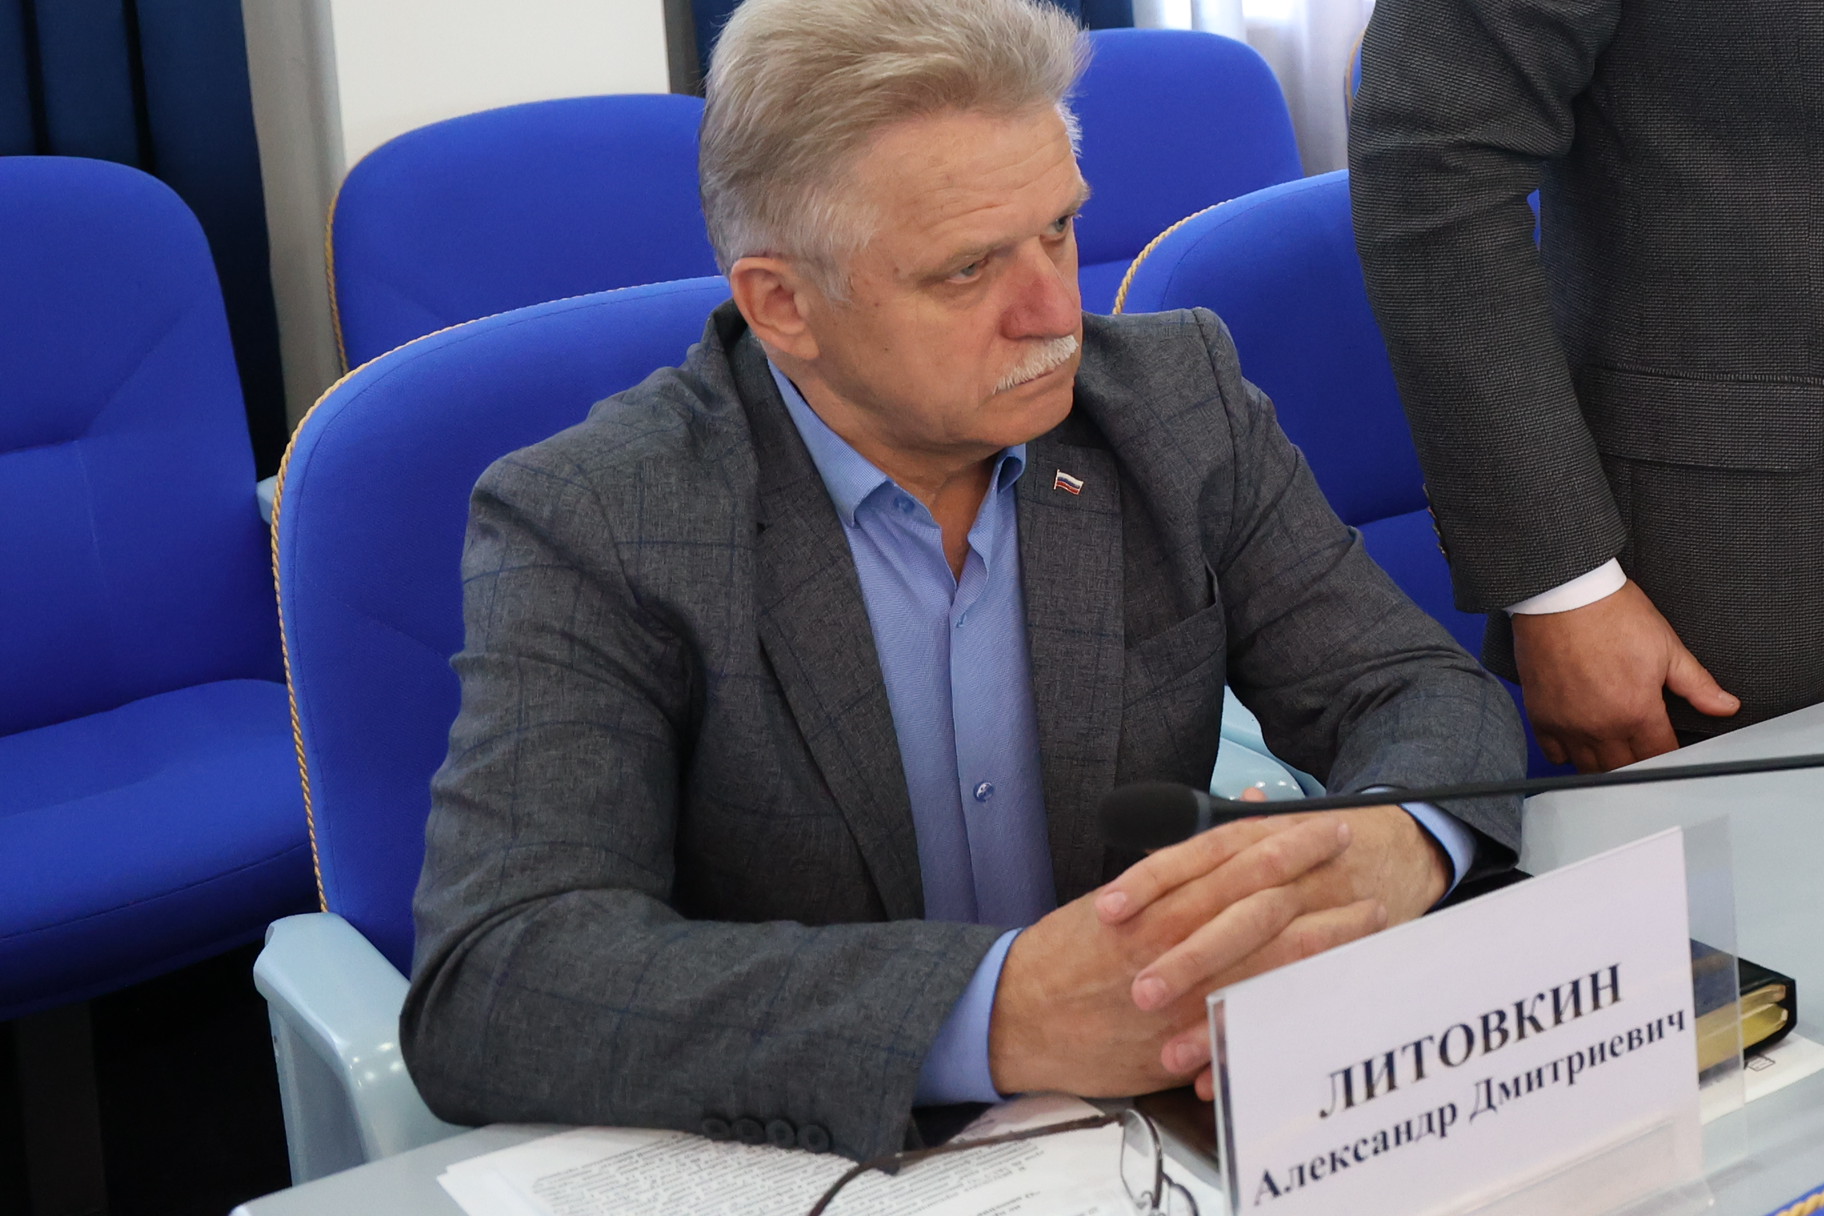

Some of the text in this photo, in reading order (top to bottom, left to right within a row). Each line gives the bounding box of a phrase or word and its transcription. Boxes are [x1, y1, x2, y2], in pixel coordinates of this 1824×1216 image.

[1253, 1009, 1687, 1207] Александр Дмитриевич
[1318, 963, 1623, 1119] ЛИТОВКИН
